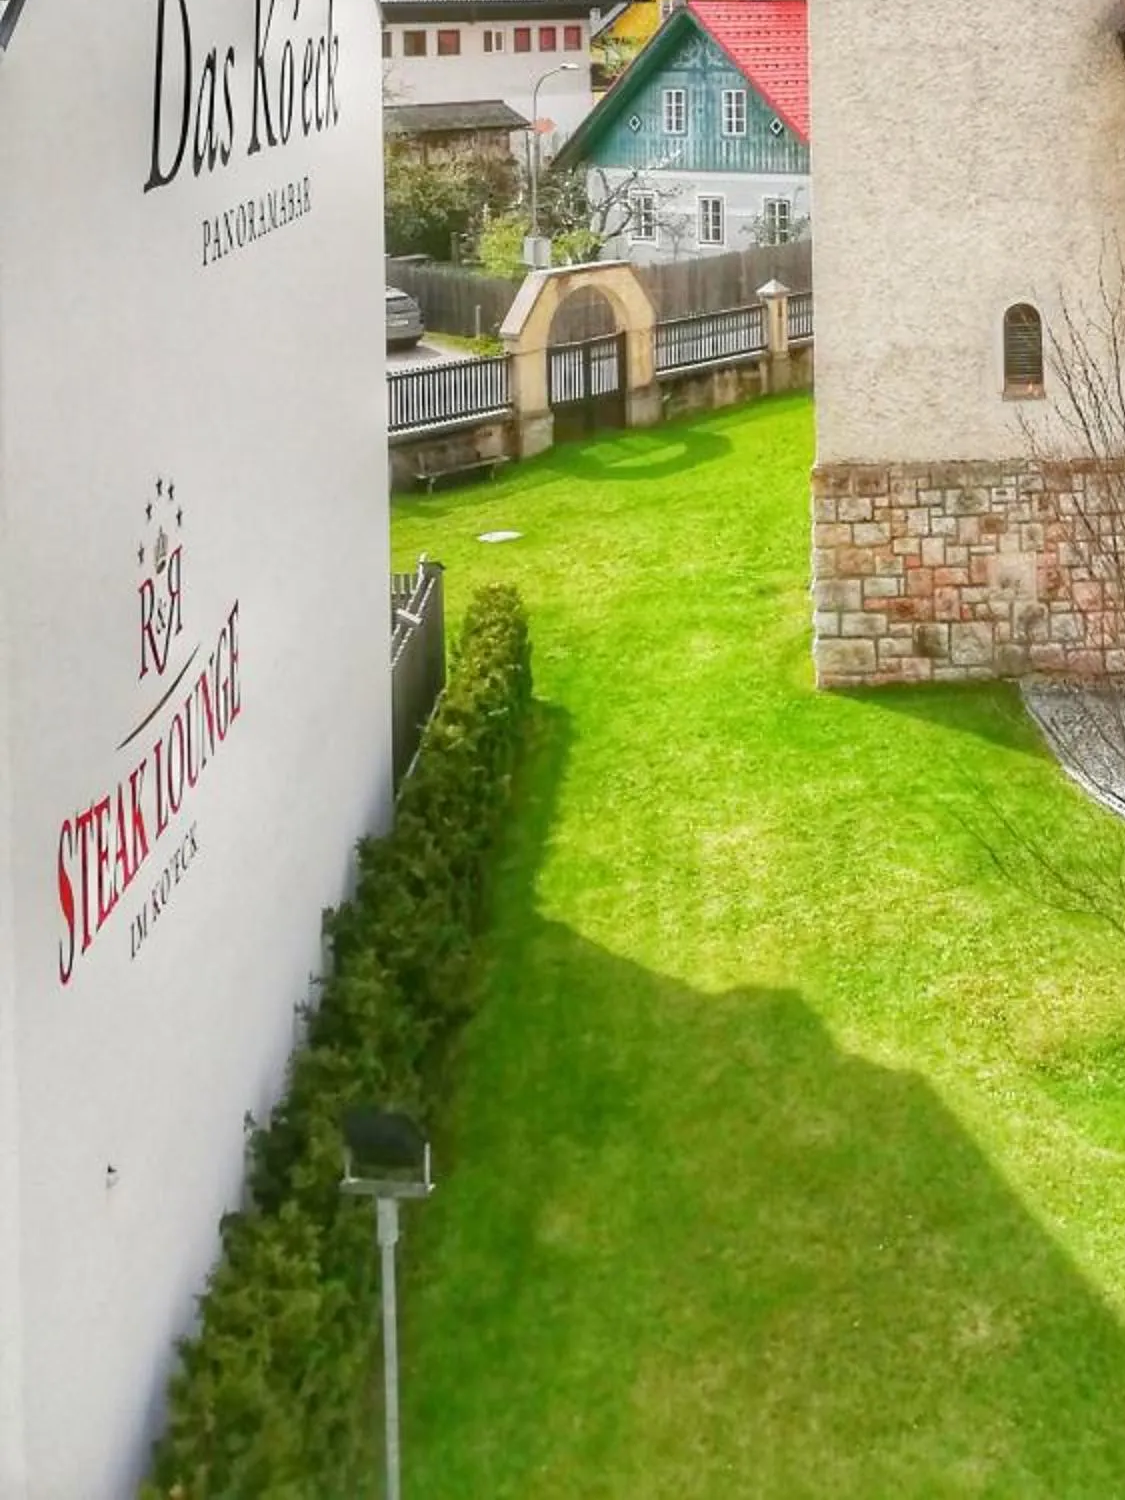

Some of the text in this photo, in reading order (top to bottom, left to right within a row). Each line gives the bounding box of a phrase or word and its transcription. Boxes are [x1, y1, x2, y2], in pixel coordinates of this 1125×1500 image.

[202, 177, 311, 266] PANORAMABAR
[58, 599, 240, 985] STEAK LOUNGE
[130, 901, 148, 960] IM
